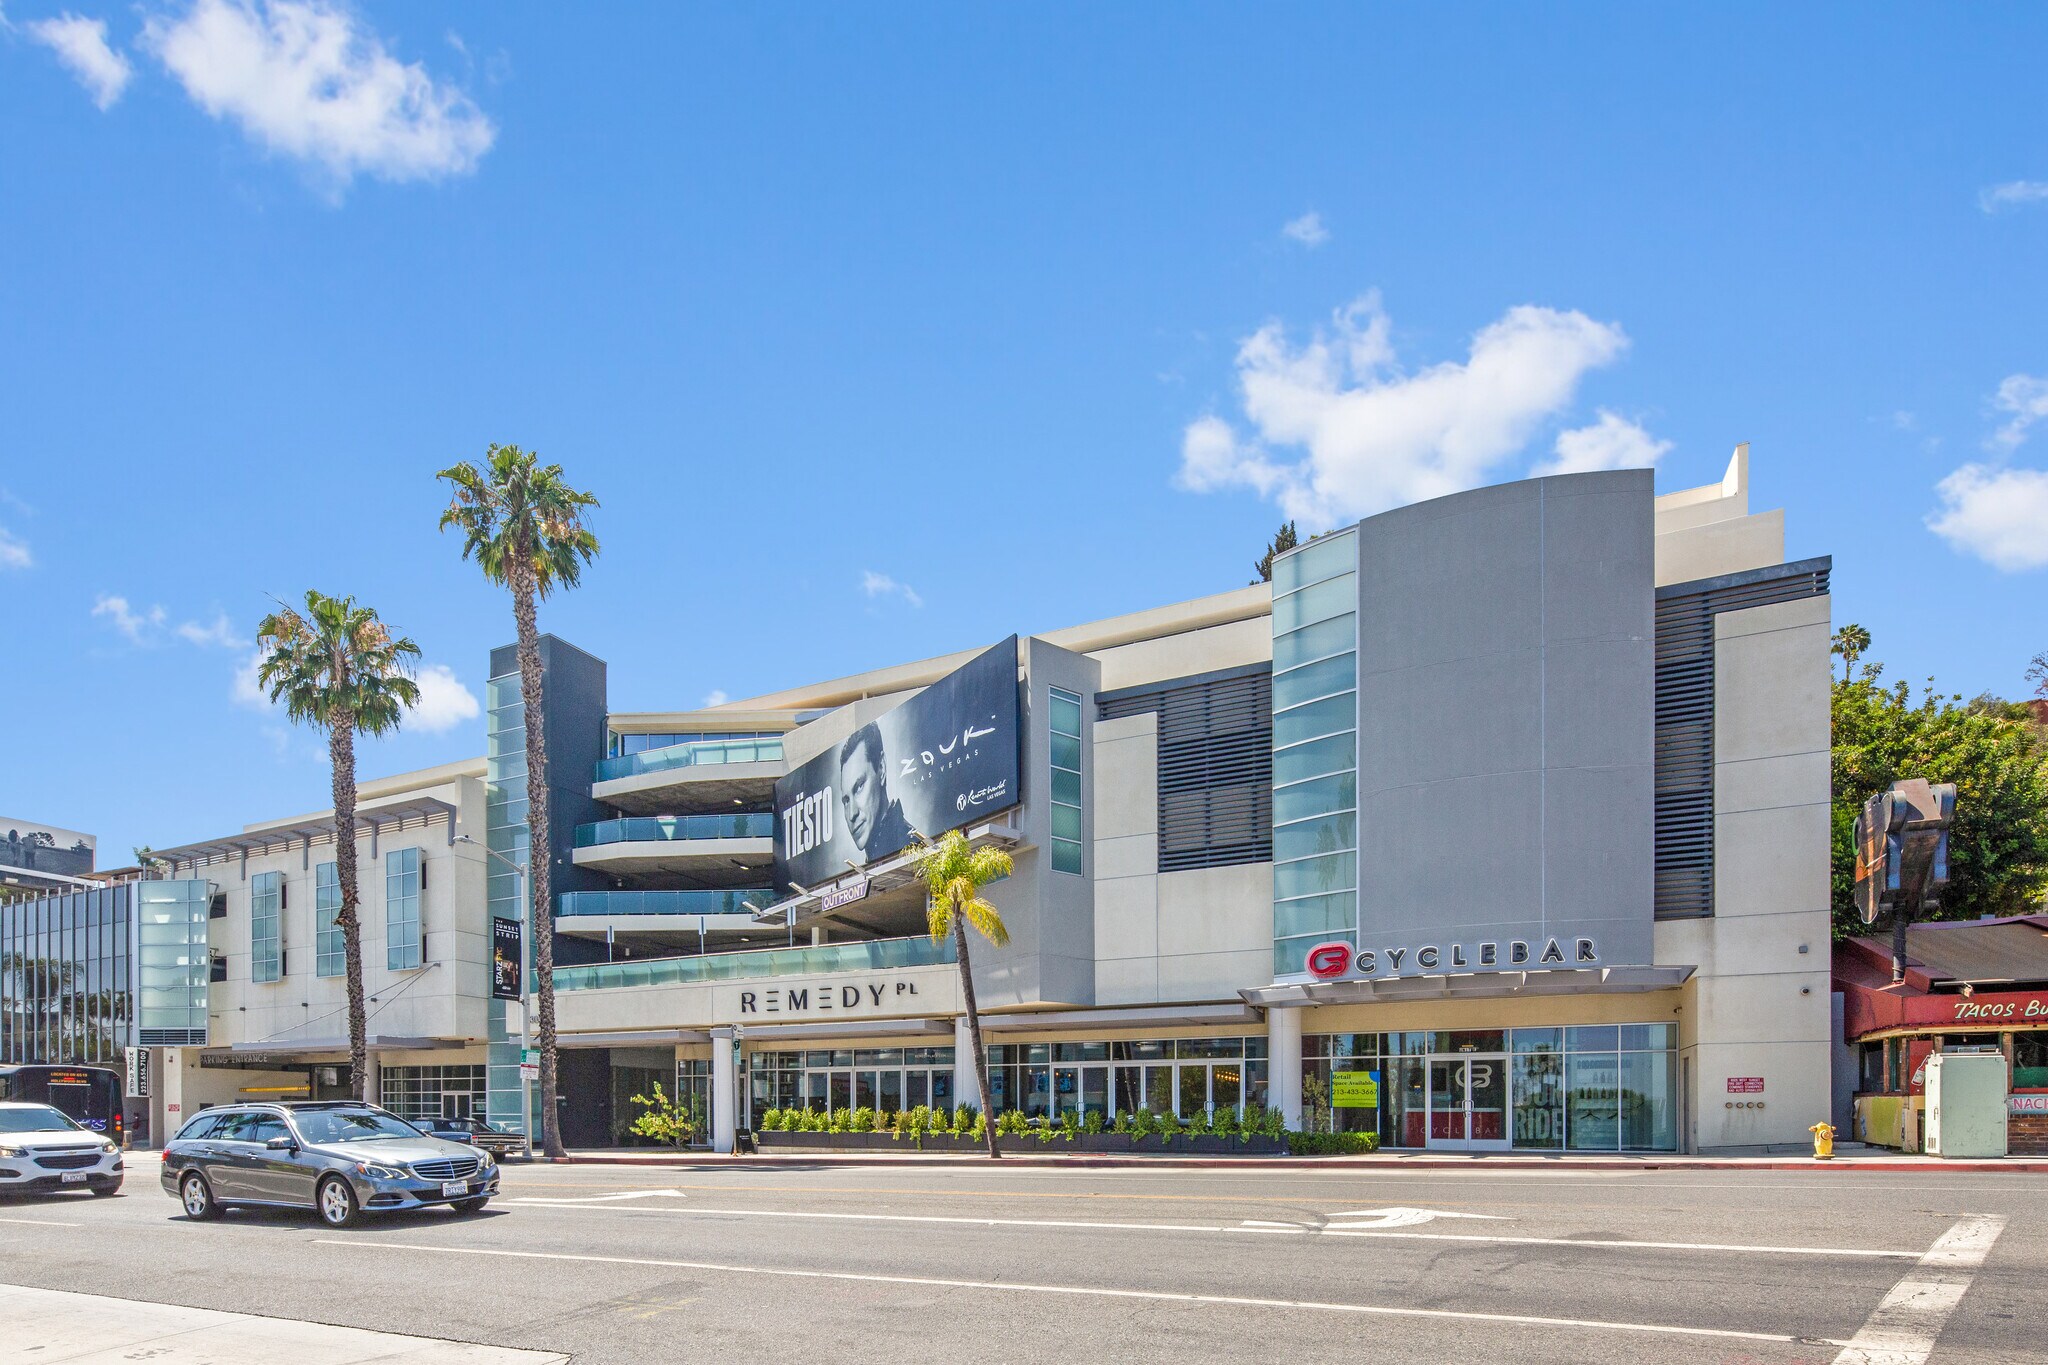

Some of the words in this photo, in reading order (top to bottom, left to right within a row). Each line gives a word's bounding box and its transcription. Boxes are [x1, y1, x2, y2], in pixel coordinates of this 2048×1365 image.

[913, 771, 932, 785] LAS
[940, 749, 978, 772] VEGAS
[783, 786, 833, 860] TIËSTO
[823, 884, 865, 908] OUTFRONT
[495, 923, 519, 932] SUNSET
[495, 930, 519, 940] STRIP
[1355, 938, 1597, 973] CYCLEBAR
[495, 961, 503, 985] STARZ
[741, 984, 885, 1012] REMEDY
[896, 982, 918, 995] PL
[1954, 1002, 2016, 1019] TACOS
[231, 1053, 268, 1063] ENTRANCE
[1515, 1108, 1563, 1140] RIDE
